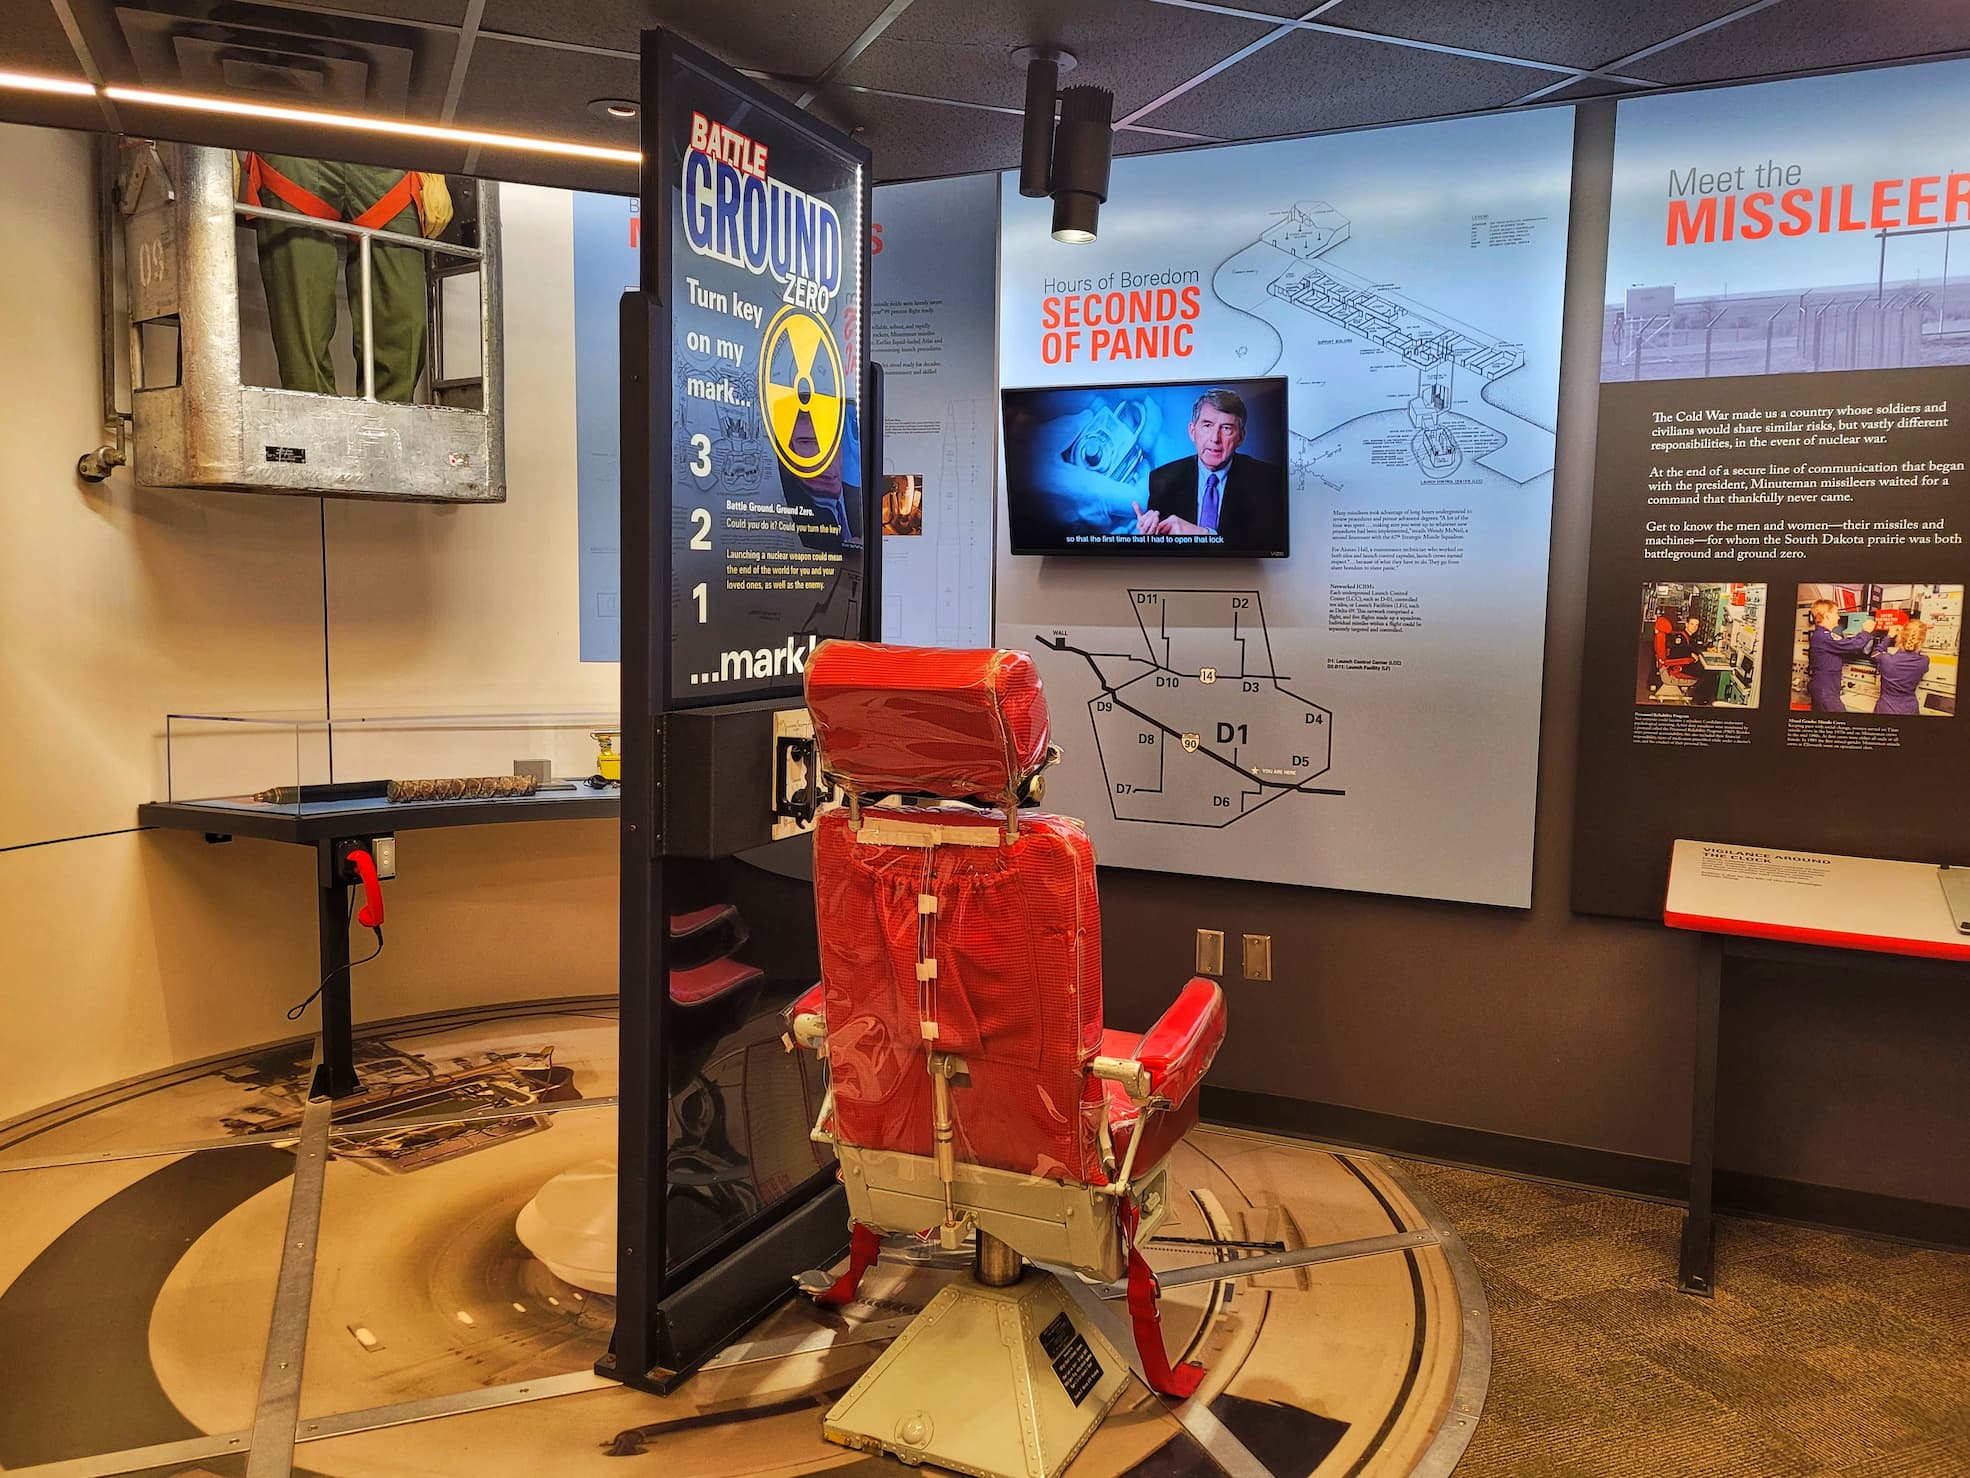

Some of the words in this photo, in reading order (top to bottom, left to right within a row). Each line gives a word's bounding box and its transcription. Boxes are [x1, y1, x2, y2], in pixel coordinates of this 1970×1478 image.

[690, 111, 768, 181] BATTLE
[1668, 166, 1745, 198] Meet
[1755, 159, 1801, 187] the
[682, 144, 842, 298] GROUND
[1043, 276, 1093, 295] Hours
[1098, 272, 1115, 290] of
[1121, 268, 1200, 288] Boredom
[782, 272, 830, 315] ZERO
[686, 277, 727, 313] Turn
[732, 292, 763, 329] key
[1041, 286, 1201, 330] SECONDS
[686, 331, 711, 354] on
[716, 337, 744, 368] my
[1041, 331, 1080, 364] OF
[1090, 323, 1194, 362] PANIC
[687, 377, 751, 408] mark...
[1652, 411, 1673, 423] The
[1676, 410, 1703, 422] Cold
[1705, 409, 1730, 421] War
[1732, 408, 1762, 420] made
[1765, 409, 1778, 418] us
[1780, 409, 1787, 418] a
[1790, 407, 1834, 420] country
[1837, 404, 1873, 416] whose
[1876, 403, 1921, 414] soldiers
[1924, 401, 1947, 413] and
[1651, 425, 1694, 437] civilians
[1697, 423, 1730, 435] would
[1733, 422, 1762, 434] share
[1765, 421, 1803, 433] similar
[1806, 420, 1836, 433] risks,
[1838, 419, 1858, 430] but
[1861, 418, 1895, 432] vastly
[1897, 416, 1949, 428] different
[1650, 438, 1733, 453] responsibilities,
[1735, 437, 1746, 448] in
[1750, 436, 1767, 447] the
[1770, 437, 1801, 447] event
[1803, 434, 1817, 446] of
[1818, 433, 1861, 445] nuclear
[1863, 435, 1888, 444] war.
[689, 433, 712, 478] 3
[1649, 466, 1664, 478] At
[1666, 466, 1684, 477] the
[1686, 465, 1706, 477] end
[1709, 465, 1722, 476] of
[1723, 468, 1730, 476] a
[1732, 466, 1767, 476] secure
[1769, 464, 1790, 475] line
[1793, 462, 1807, 474] of
[1808, 461, 1898, 473] communication
[1901, 460, 1926, 472] that
[1929, 460, 1965, 474] began
[1648, 480, 1672, 492] with
[1675, 479, 1692, 491] the
[1695, 478, 1749, 493] president,
[1750, 477, 1817, 489] Minuteman
[1820, 475, 1876, 488] missileers
[1879, 475, 1918, 487] waited
[1921, 474, 1939, 486] for
[1942, 477, 1950, 486] a
[1647, 493, 1700, 505] command
[1703, 493, 1725, 504] that
[1728, 492, 1784, 506] thankfully
[1787, 493, 1818, 503] never
[1820, 493, 1854, 502] came.
[726, 499, 748, 512] Battle
[748, 501, 775, 514] Ground.
[775, 504, 799, 516] Ground
[799, 506, 815, 517] Zero.
[690, 508, 712, 550] 2
[726, 517, 746, 529] Could
[748, 520, 761, 532] you
[760, 519, 769, 530] do
[778, 521, 796, 532] Could
[796, 524, 807, 533] you
[807, 524, 819, 533] turn
[820, 524, 829, 534] the
[829, 525, 842, 536] key?
[1646, 520, 1667, 532] Get
[1669, 522, 1681, 532] to
[1683, 520, 1714, 532] know
[1716, 520, 1734, 531] the
[1736, 522, 1761, 531] men
[1763, 519, 1784, 531] and
[1873, 518, 1919, 530] missiles
[1922, 518, 1945, 529] and
[1075, 535, 1089, 543] that
[1090, 535, 1101, 543] the
[1102, 535, 1115, 543] first
[1116, 535, 1131, 543] time
[1132, 535, 1146, 543] that
[1151, 535, 1164, 543] had
[1174, 536, 1192, 545] open
[1193, 535, 1208, 543] that
[1208, 535, 1224, 544] lock
[1725, 533, 1760, 545] whom
[1763, 533, 1782, 545] the
[1784, 533, 1818, 545] South
[1821, 533, 1865, 545] Dakota
[1867, 533, 1906, 547] prairie
[1908, 535, 1931, 544] was
[1934, 533, 1963, 545] both
[726, 549, 761, 562] Launching
[767, 550, 788, 560] nuclear
[789, 552, 812, 562] weapon
[812, 552, 827, 561] could
[1644, 548, 1712, 562] battleground
[1714, 548, 1735, 560] and
[1737, 548, 1777, 562] ground
[1779, 550, 1807, 559] zero.
[726, 565, 738, 575] the
[739, 565, 752, 575] end
[752, 565, 760, 575] of
[760, 565, 772, 575] the
[772, 565, 790, 575] world
[790, 566, 799, 575] for
[799, 567, 811, 577] you
[811, 566, 822, 575] and
[822, 567, 835, 577] your
[726, 580, 745, 590] loved
[746, 581, 764, 591] ones,
[764, 581, 772, 590] as
[773, 580, 786, 590] well
[786, 581, 794, 590] as
[795, 580, 804, 590] the
[805, 581, 825, 592] enemy.
[692, 582, 708, 623] 1
[1137, 593, 1158, 605] D11
[1232, 597, 1249, 609] D2
[1156, 676, 1179, 689] D10
[1203, 671, 1213, 681] 14
[1243, 682, 1259, 693] D3
[1097, 702, 1113, 713] D9
[1305, 713, 1323, 725] D4
[1138, 734, 1155, 745] D8
[1216, 722, 1248, 744] D1
[1184, 739, 1197, 749] 90
[1292, 755, 1310, 767] D5
[1116, 783, 1132, 794] D7
[1213, 796, 1230, 808] D6
[1703, 847, 1771, 858] VIGILANCE
[1775, 855, 1831, 864] AROUND
[1730, 855, 1772, 864] CLOCK
